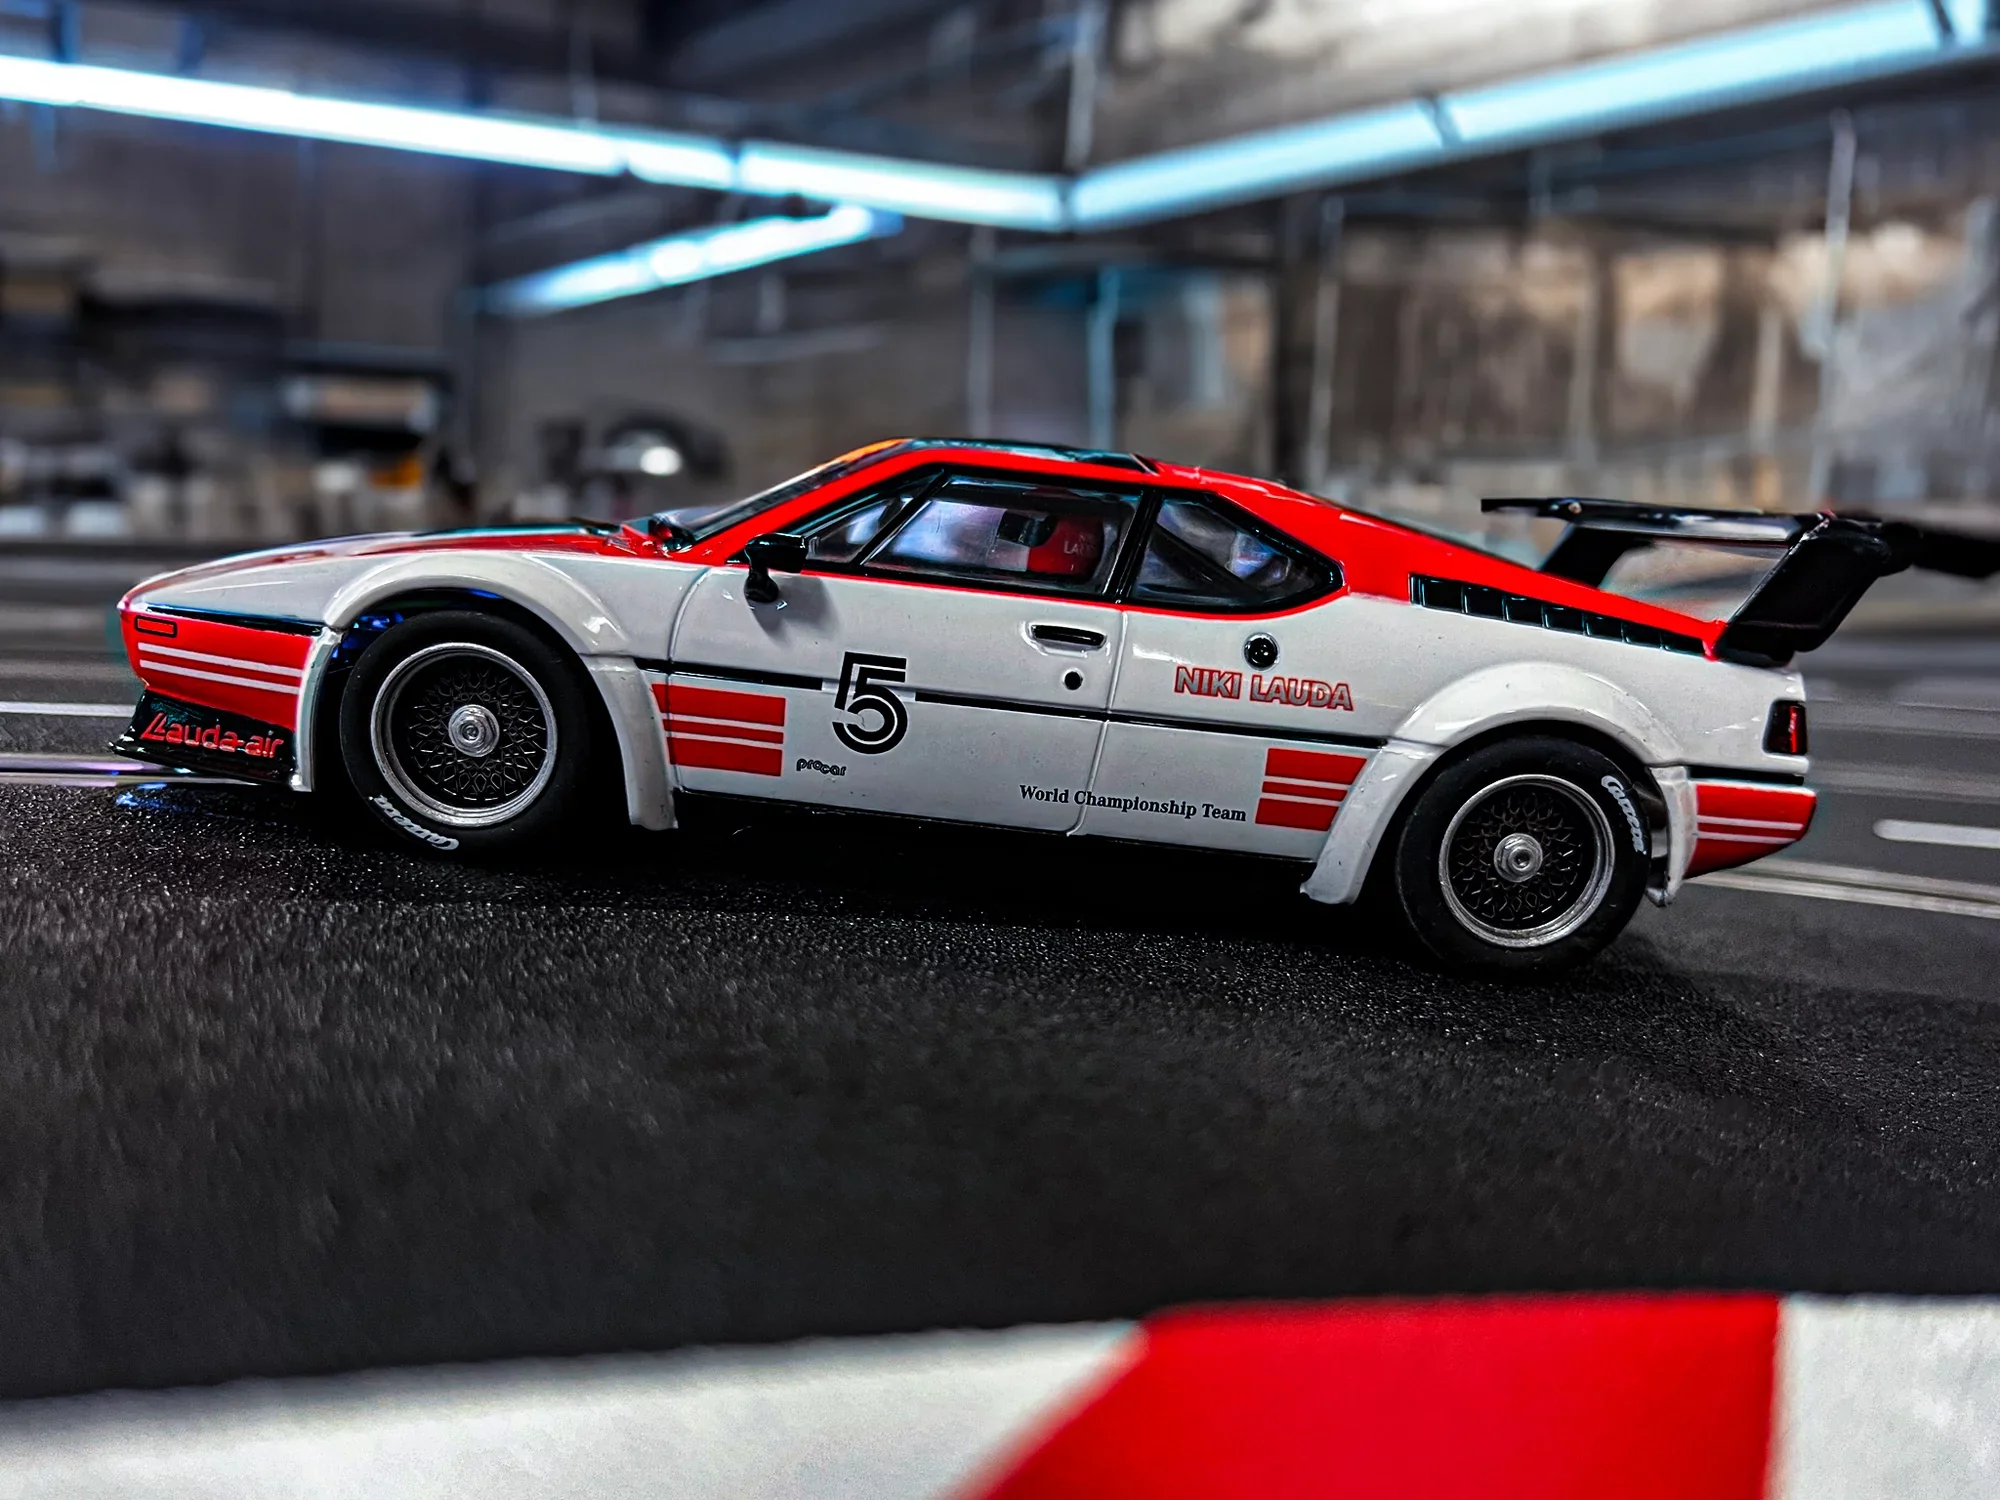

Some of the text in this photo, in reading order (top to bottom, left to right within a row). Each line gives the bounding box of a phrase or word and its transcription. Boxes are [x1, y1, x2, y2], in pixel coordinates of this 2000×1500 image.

[831, 651, 909, 755] 5
[1174, 665, 1354, 712] NIKI LAUDA
[140, 712, 285, 758] Lauda-air
[795, 757, 847, 777] procar
[1019, 784, 1247, 822] World Championship Team
[1600, 775, 1645, 853] Carrera
